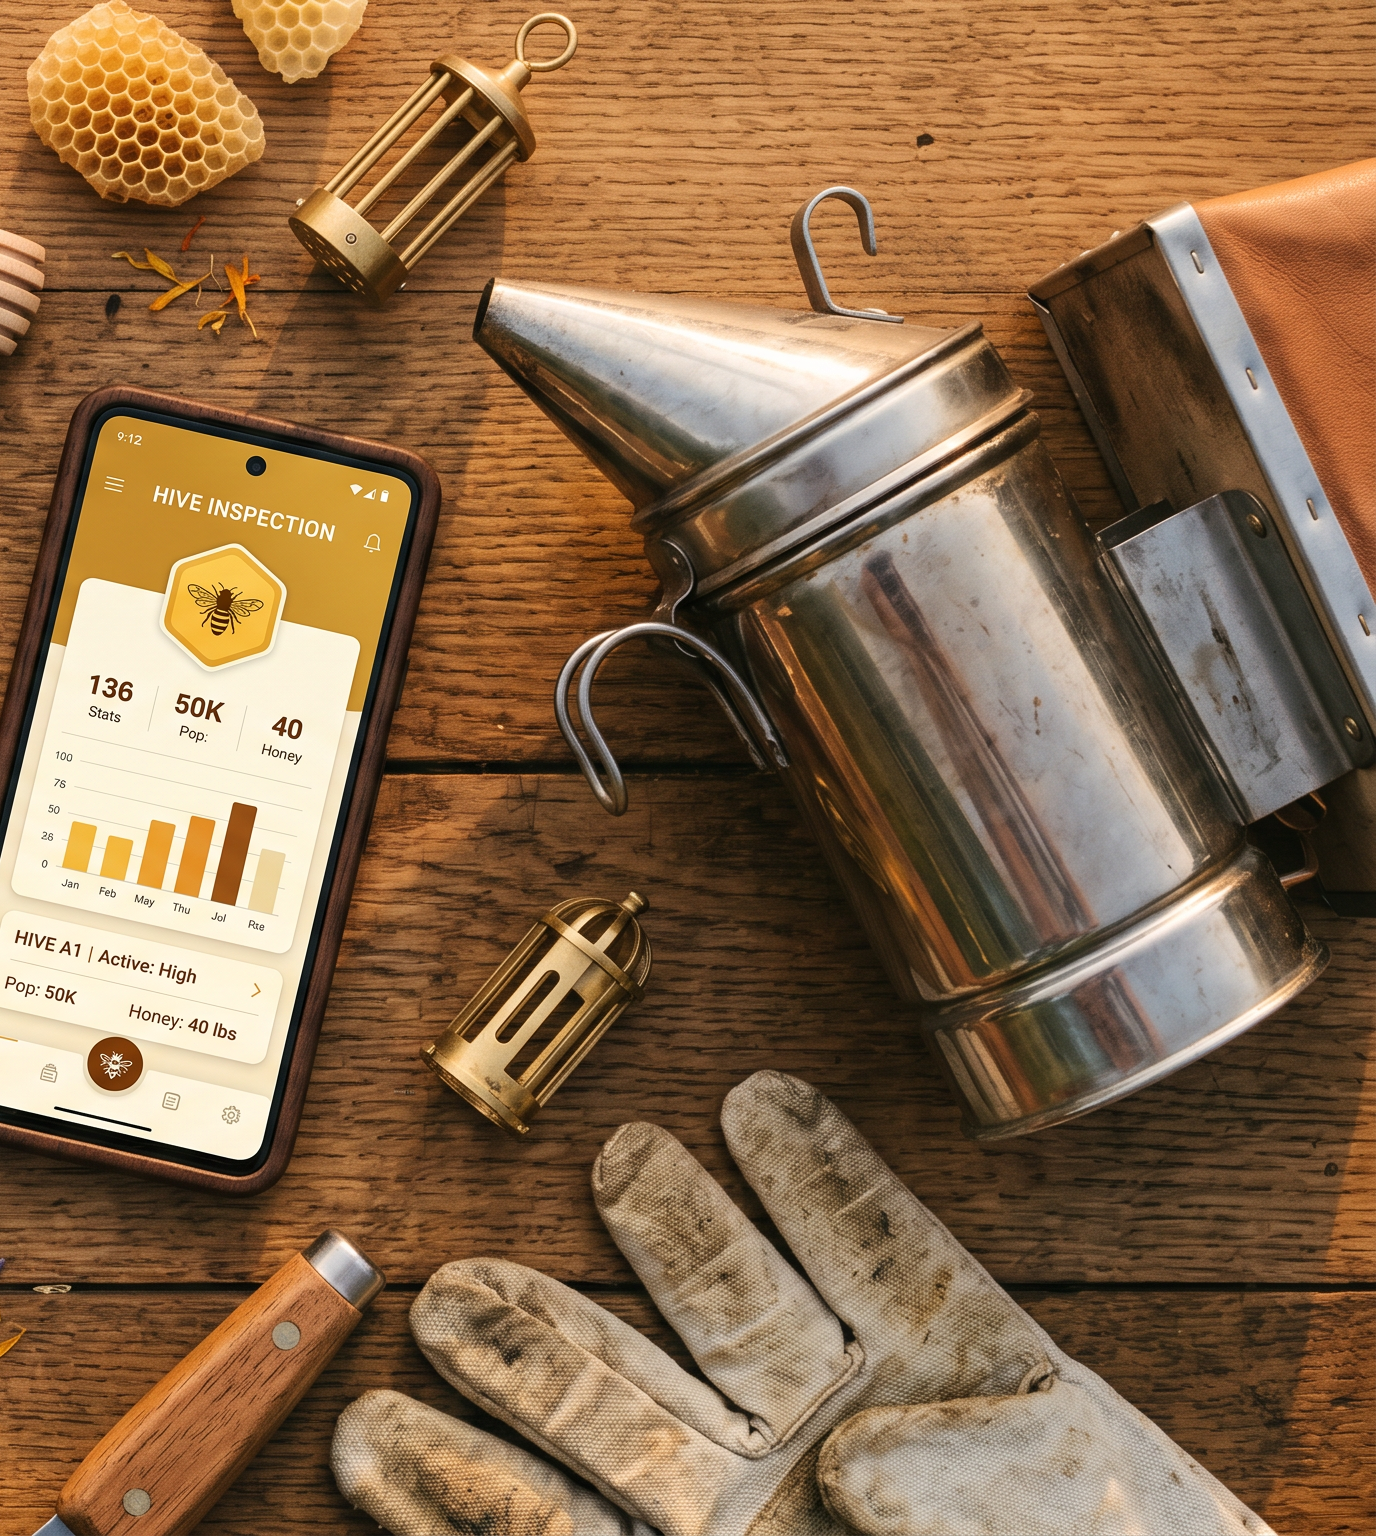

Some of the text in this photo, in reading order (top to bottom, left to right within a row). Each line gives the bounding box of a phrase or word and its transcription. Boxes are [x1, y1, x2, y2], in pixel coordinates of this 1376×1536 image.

[116, 431, 143, 446] 9:12
[152, 485, 336, 542] HIVE INSPECTION
[89, 674, 134, 702] 136
[88, 705, 122, 723] Stats
[174, 693, 225, 723] 50K
[179, 725, 209, 743] Pop:
[271, 716, 304, 740] 40
[55, 751, 74, 763] 100
[261, 743, 303, 765] Honey
[47, 804, 61, 815] 50
[41, 858, 48, 869] 0
[61, 879, 80, 890] Jan
[99, 886, 117, 899] Feb
[134, 894, 155, 908] May
[173, 902, 191, 915] Thu
[14, 929, 57, 953] HIVE
[59, 940, 82, 957] A1
[97, 949, 155, 975] Active:
[158, 962, 197, 985] High
[4, 975, 78, 1005] Pop: 50K
[128, 1003, 237, 1041] Honey: 40 lbs
